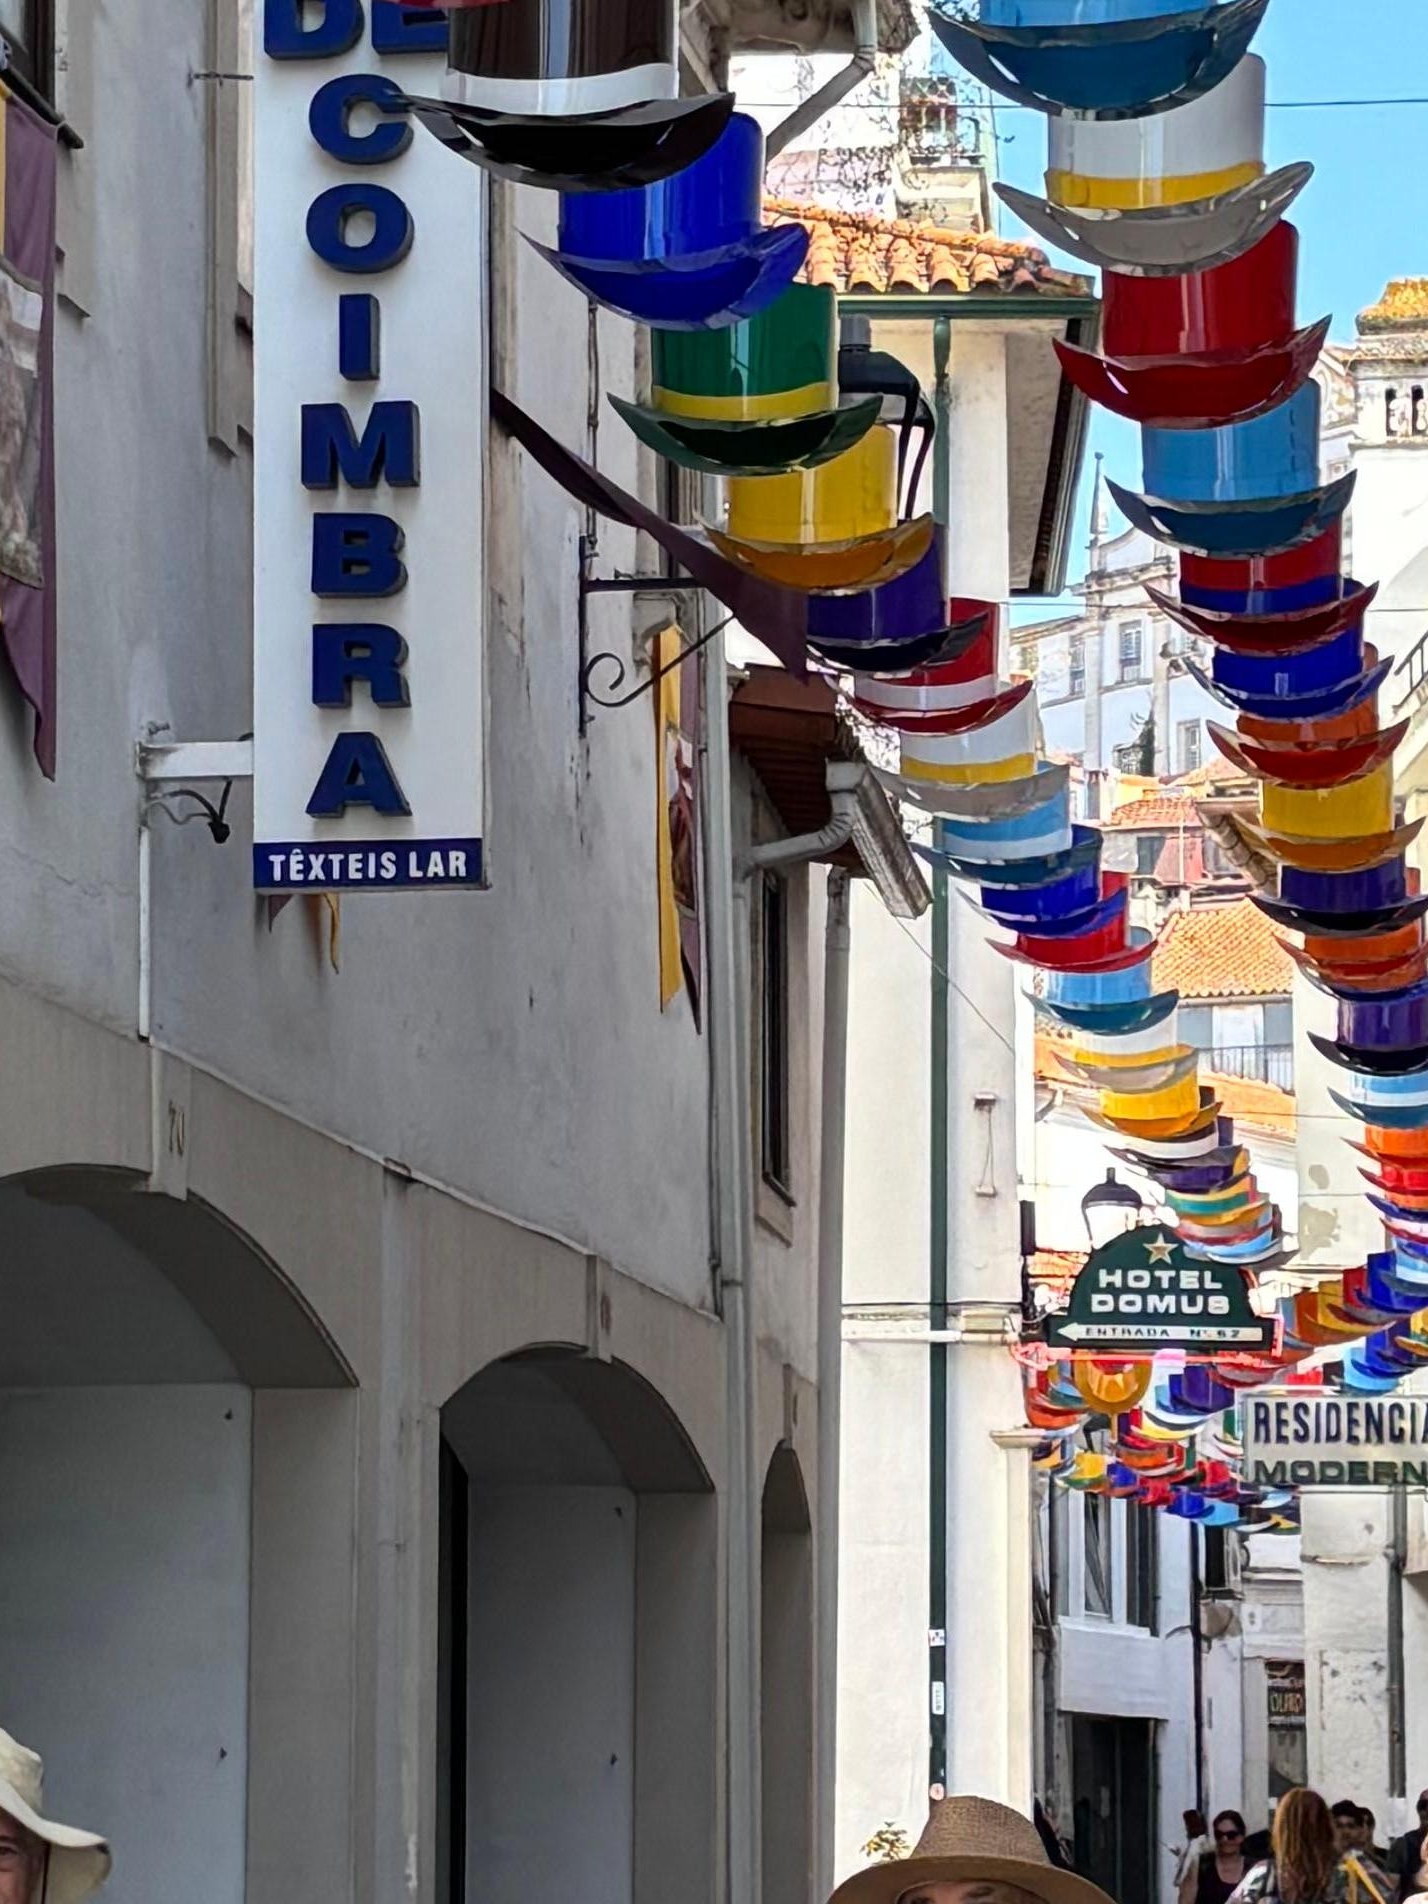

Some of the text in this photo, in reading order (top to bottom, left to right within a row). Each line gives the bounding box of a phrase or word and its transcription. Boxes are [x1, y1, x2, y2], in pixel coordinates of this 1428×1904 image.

[300, 73, 420, 820] COIMBRA
[268, 848, 468, 882] TÊXTEIS LAR
[1098, 1268, 1223, 1290] HOTEL
[1090, 1293, 1230, 1315] DOMUS
[1085, 1327, 1171, 1337] ENTRADA
